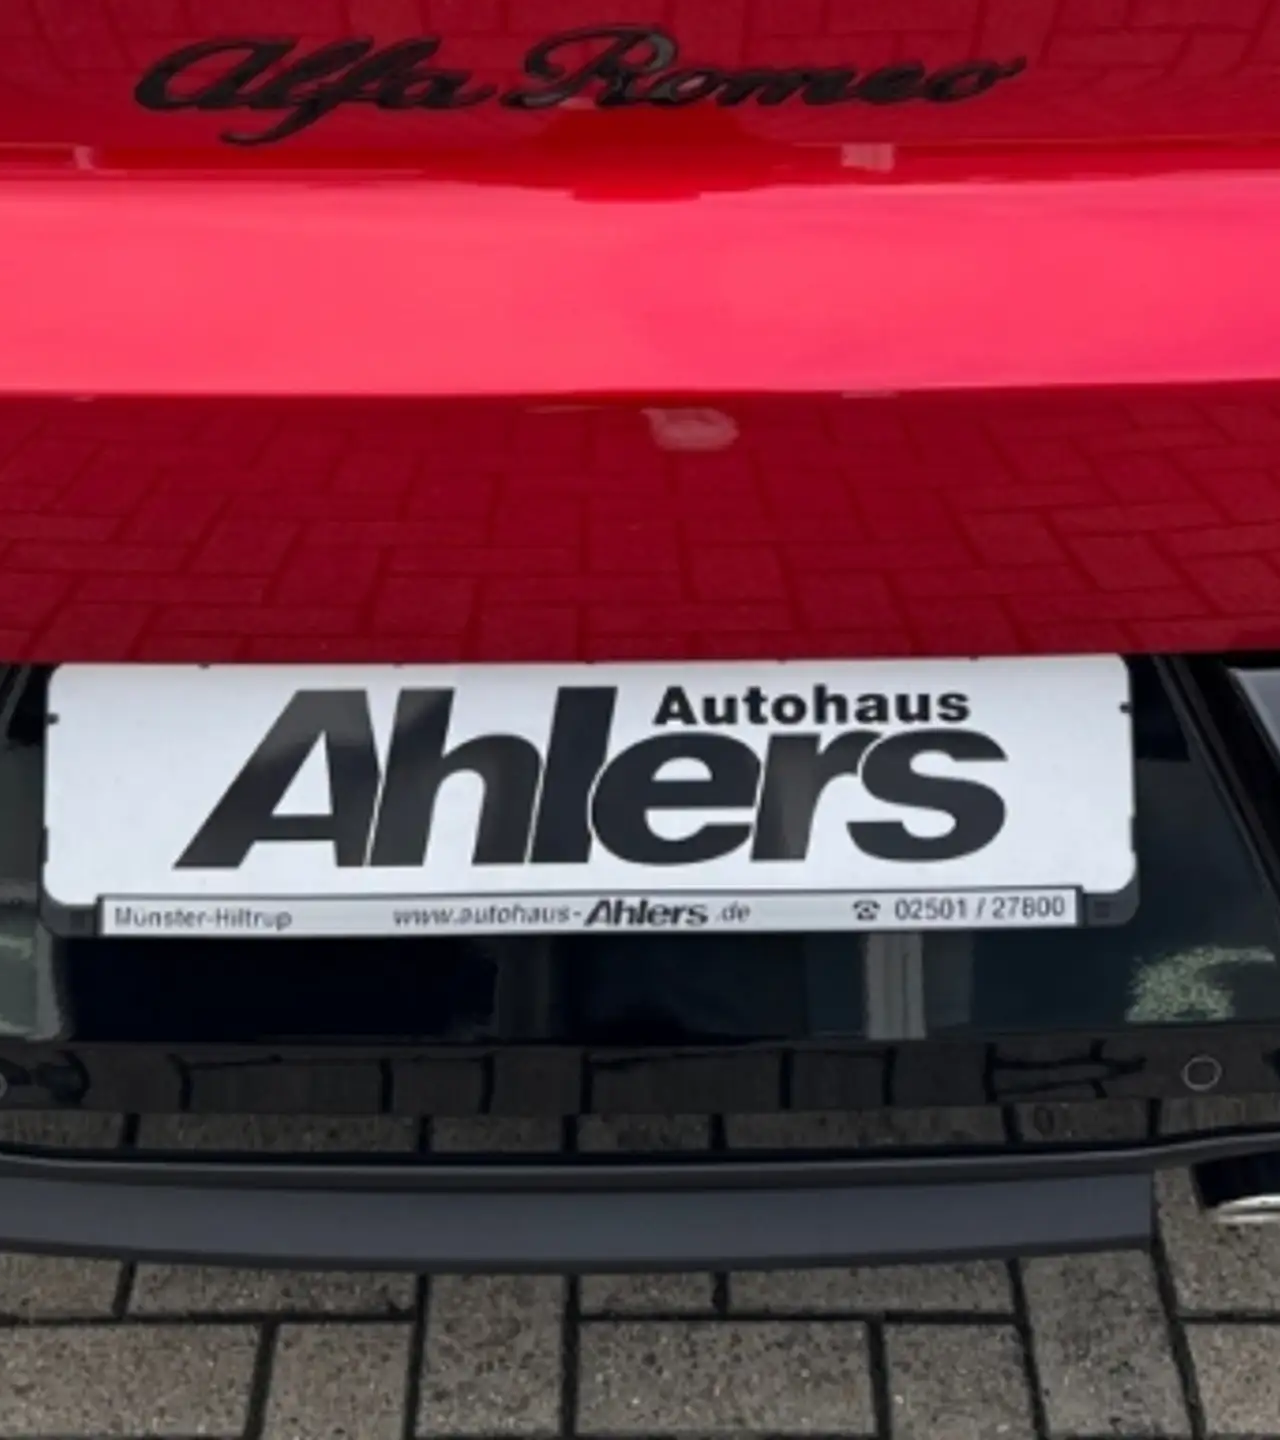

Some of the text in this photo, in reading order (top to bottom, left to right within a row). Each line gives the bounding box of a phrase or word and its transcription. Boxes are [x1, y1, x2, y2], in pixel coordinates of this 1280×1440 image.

[131, 21, 1030, 146] Alfa Romeo
[652, 684, 971, 726] Autohaus
[172, 685, 1010, 868] Ahlers
[894, 898, 968, 921] 02501
[992, 896, 1066, 919] 27800
